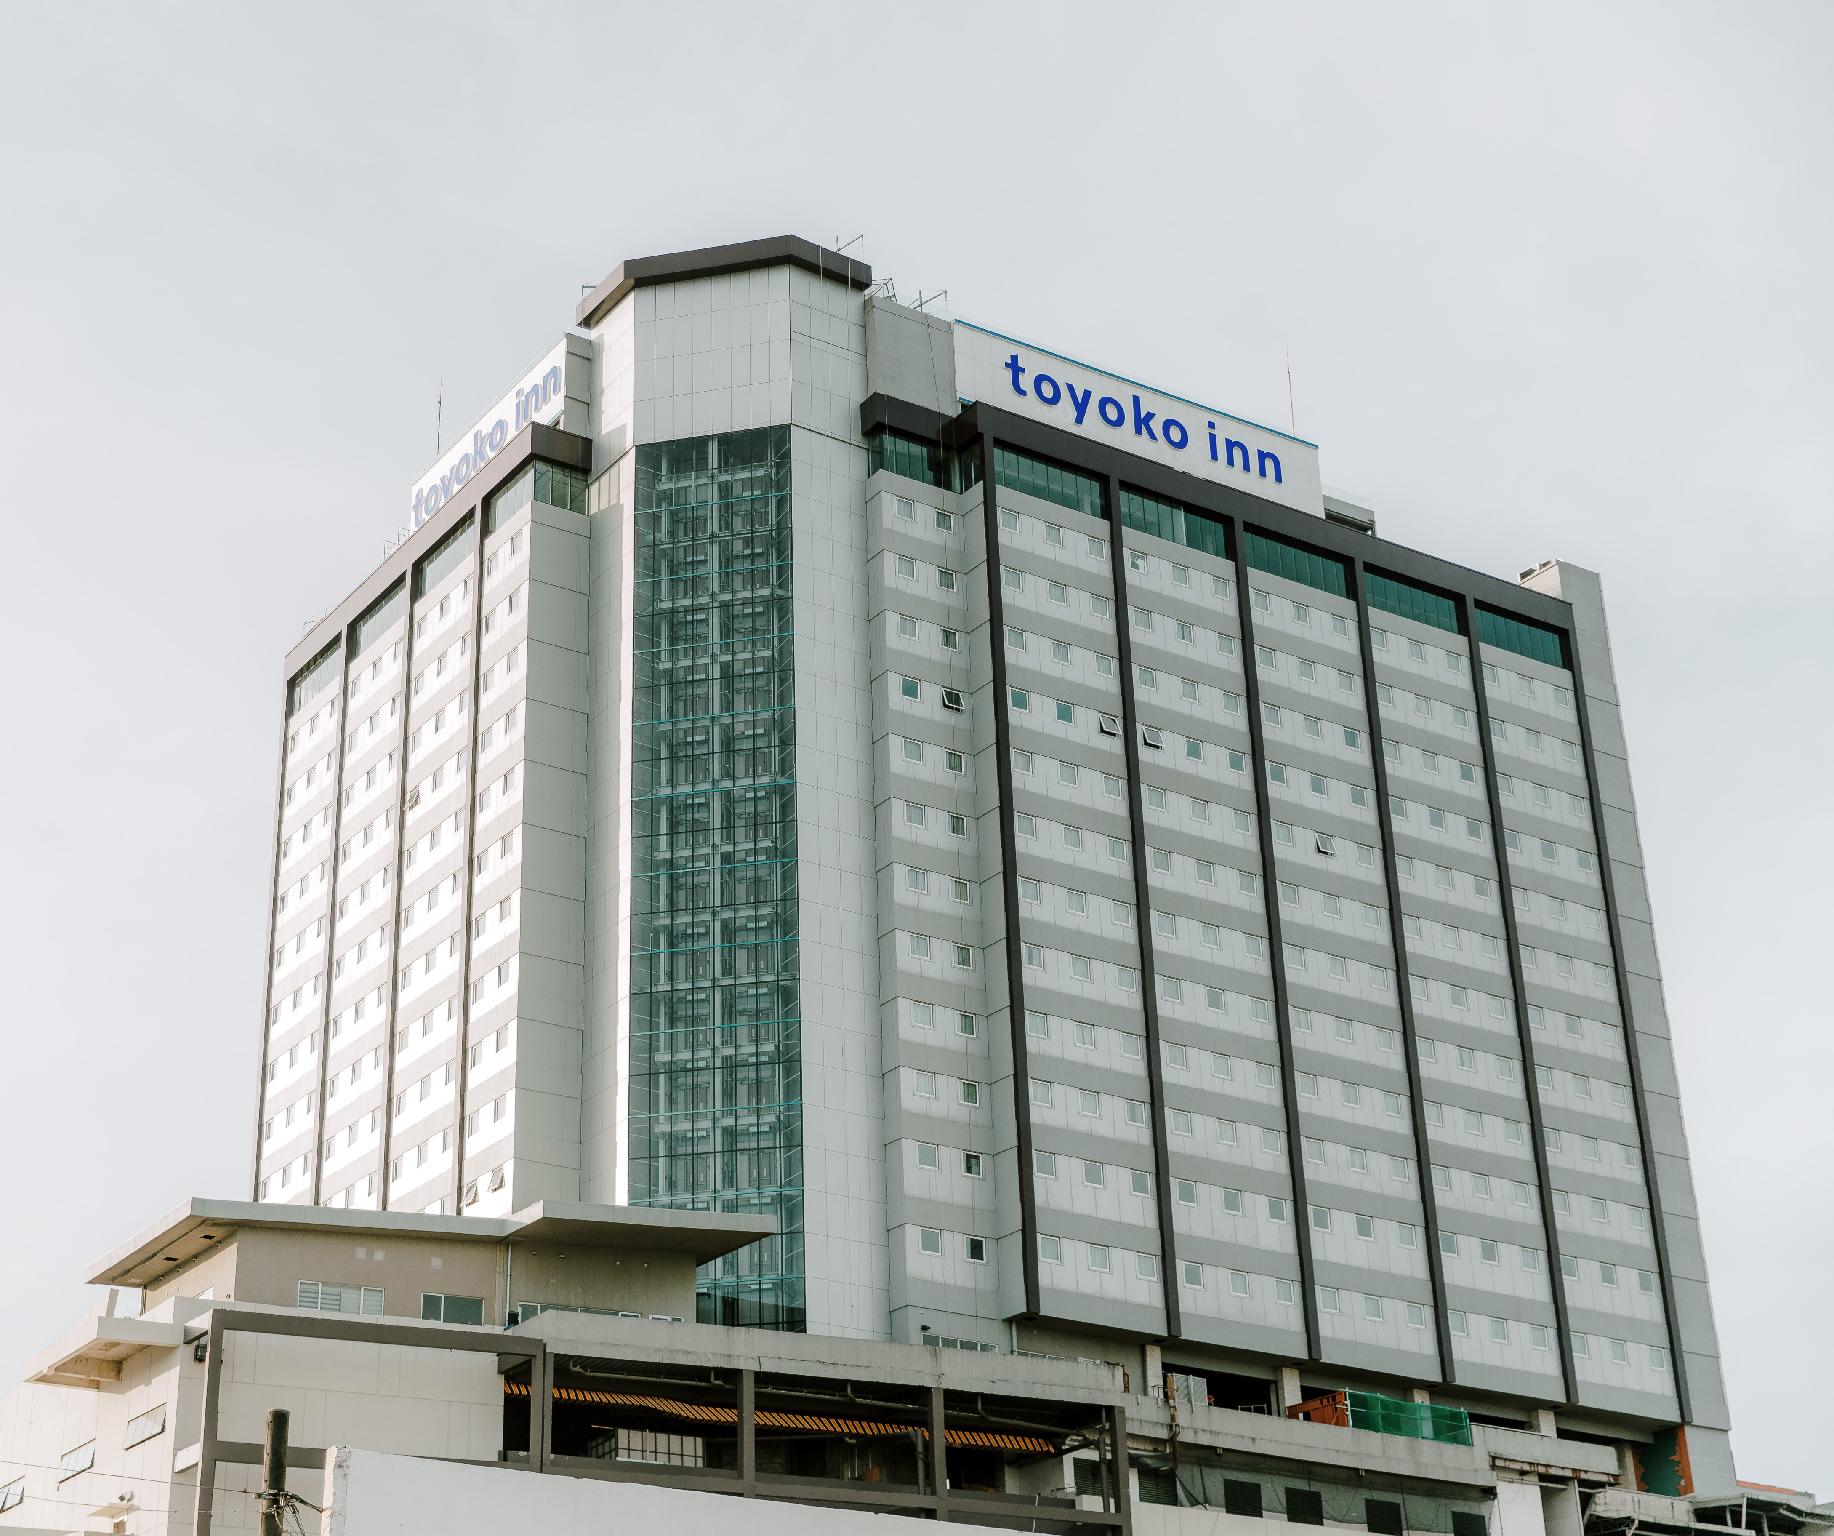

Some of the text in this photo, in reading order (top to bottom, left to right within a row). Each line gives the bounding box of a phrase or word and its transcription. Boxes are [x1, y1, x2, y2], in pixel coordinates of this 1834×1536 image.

[412, 365, 561, 528] toyoko inn
[1004, 354, 1284, 484] toyoko inn
